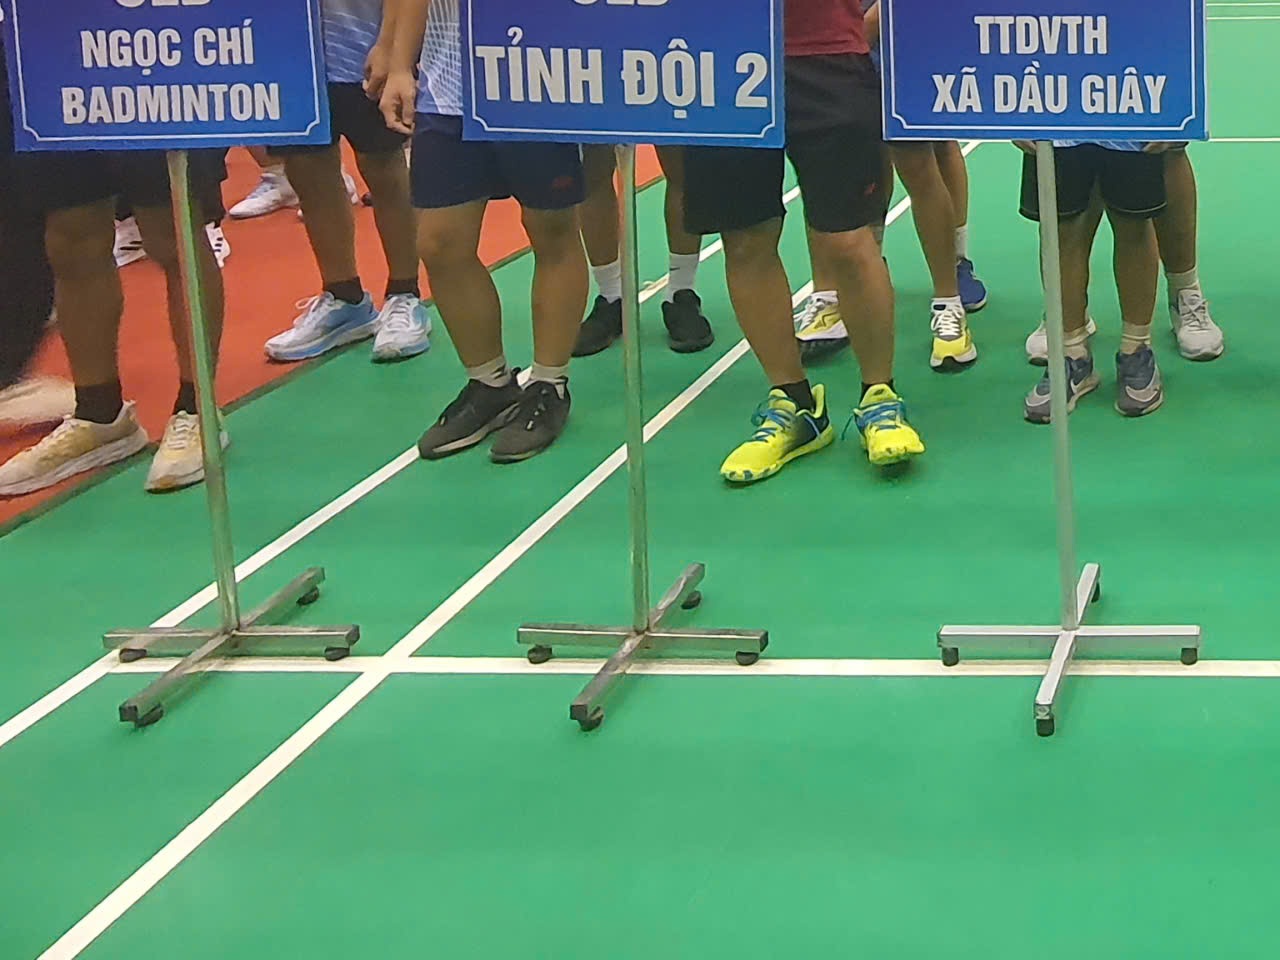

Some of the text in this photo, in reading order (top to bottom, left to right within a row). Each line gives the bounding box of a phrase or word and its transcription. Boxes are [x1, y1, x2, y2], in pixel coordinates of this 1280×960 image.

[80, 18, 255, 76] NGỌC CHÍ
[974, 15, 1108, 55] TTDVTH
[474, 26, 768, 119] TỈNH ĐỘI 2
[931, 60, 1167, 114] XÃ DẦU GIÂY
[61, 82, 281, 124] BADMINTON
